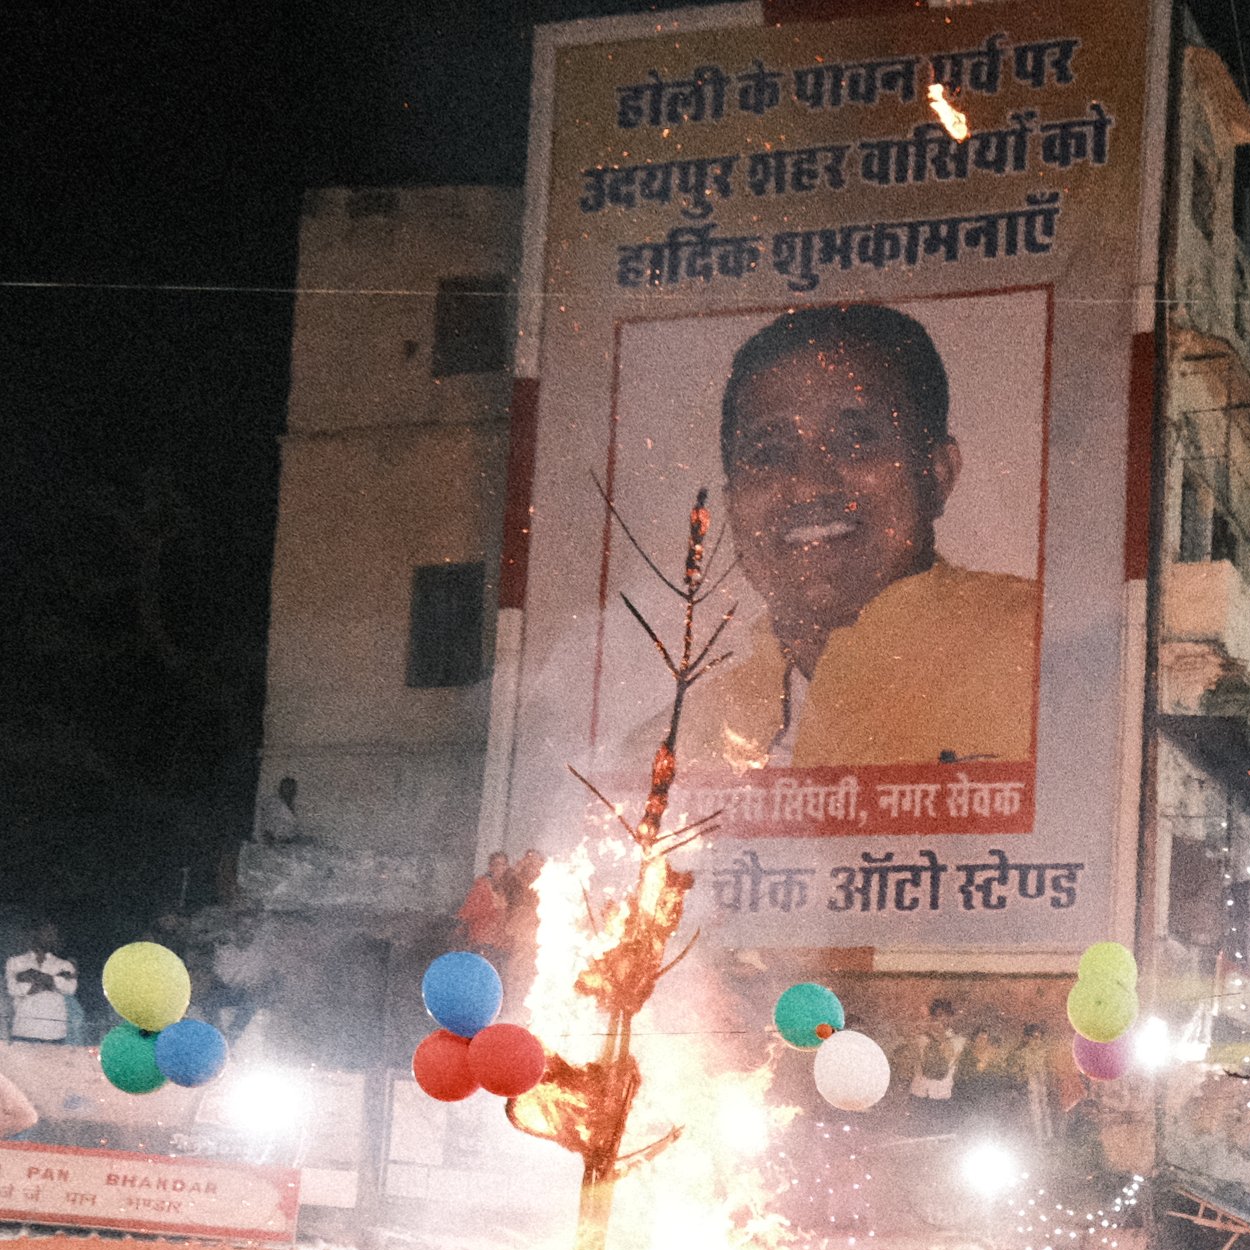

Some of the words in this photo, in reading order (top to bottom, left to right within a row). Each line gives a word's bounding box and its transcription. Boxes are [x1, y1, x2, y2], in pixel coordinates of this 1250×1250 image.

[616, 65, 730, 129] होली
[736, 60, 784, 115] के
[794, 56, 918, 108] पावन
[1013, 37, 1080, 88] पर
[579, 154, 742, 220] उदयपुर
[747, 143, 851, 196] शहर
[1040, 102, 1111, 168] को
[616, 222, 763, 288] हार्दिक
[875, 783, 942, 818] नगर
[946, 771, 1026, 818] सेवक
[713, 850, 816, 914] चौक
[827, 850, 947, 912] ऑटो
[26, 1166, 70, 1182] PAN
[105, 1173, 219, 1194] BHANDAR
